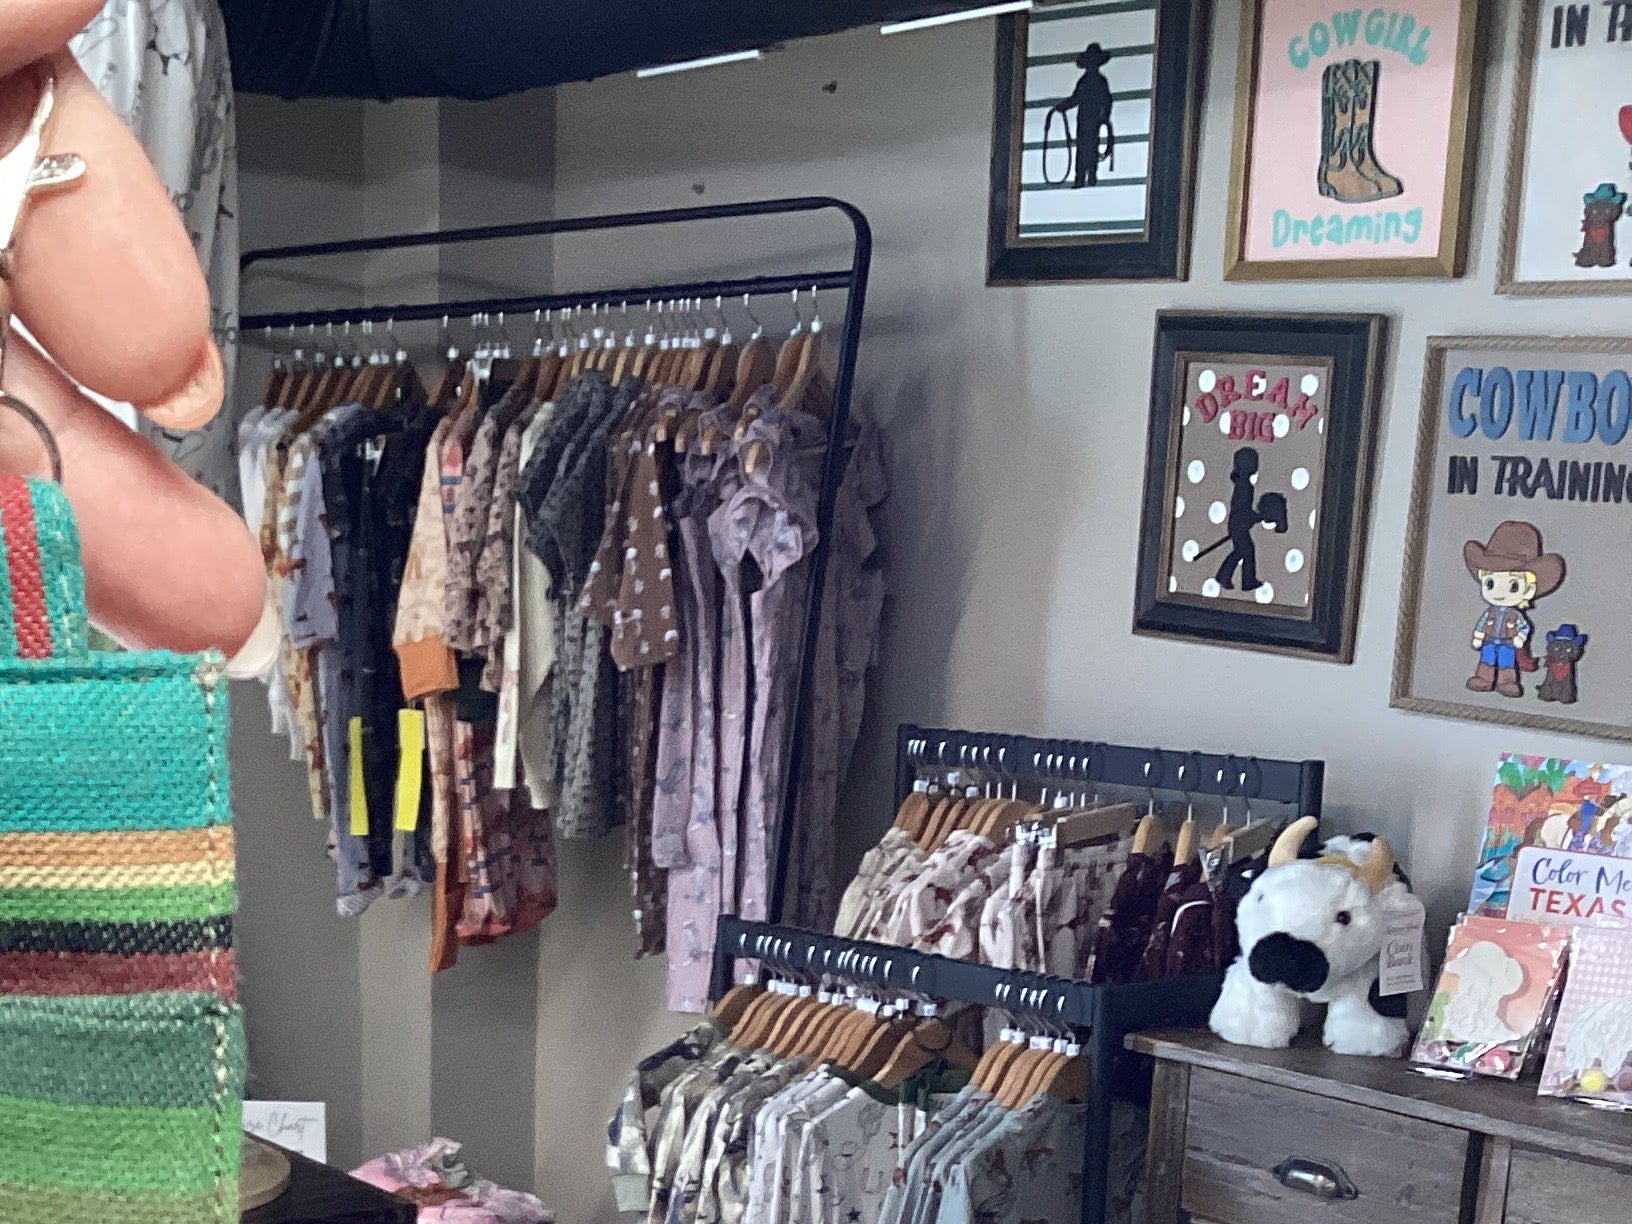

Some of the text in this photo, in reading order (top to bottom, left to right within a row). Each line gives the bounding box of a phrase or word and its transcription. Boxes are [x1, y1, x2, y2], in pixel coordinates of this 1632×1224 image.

[1288, 8, 1430, 70] COWGIRL
[1551, 4, 1589, 48] IN
[1272, 207, 1423, 249] Dreaming
[1195, 370, 1318, 431] DREAM
[1449, 367, 1632, 446] COWBO
[1227, 410, 1276, 443] BIG
[1448, 455, 1632, 503] IN TRAININ
[1532, 857, 1632, 895] Color Me
[1530, 887, 1626, 918] TEXAS
